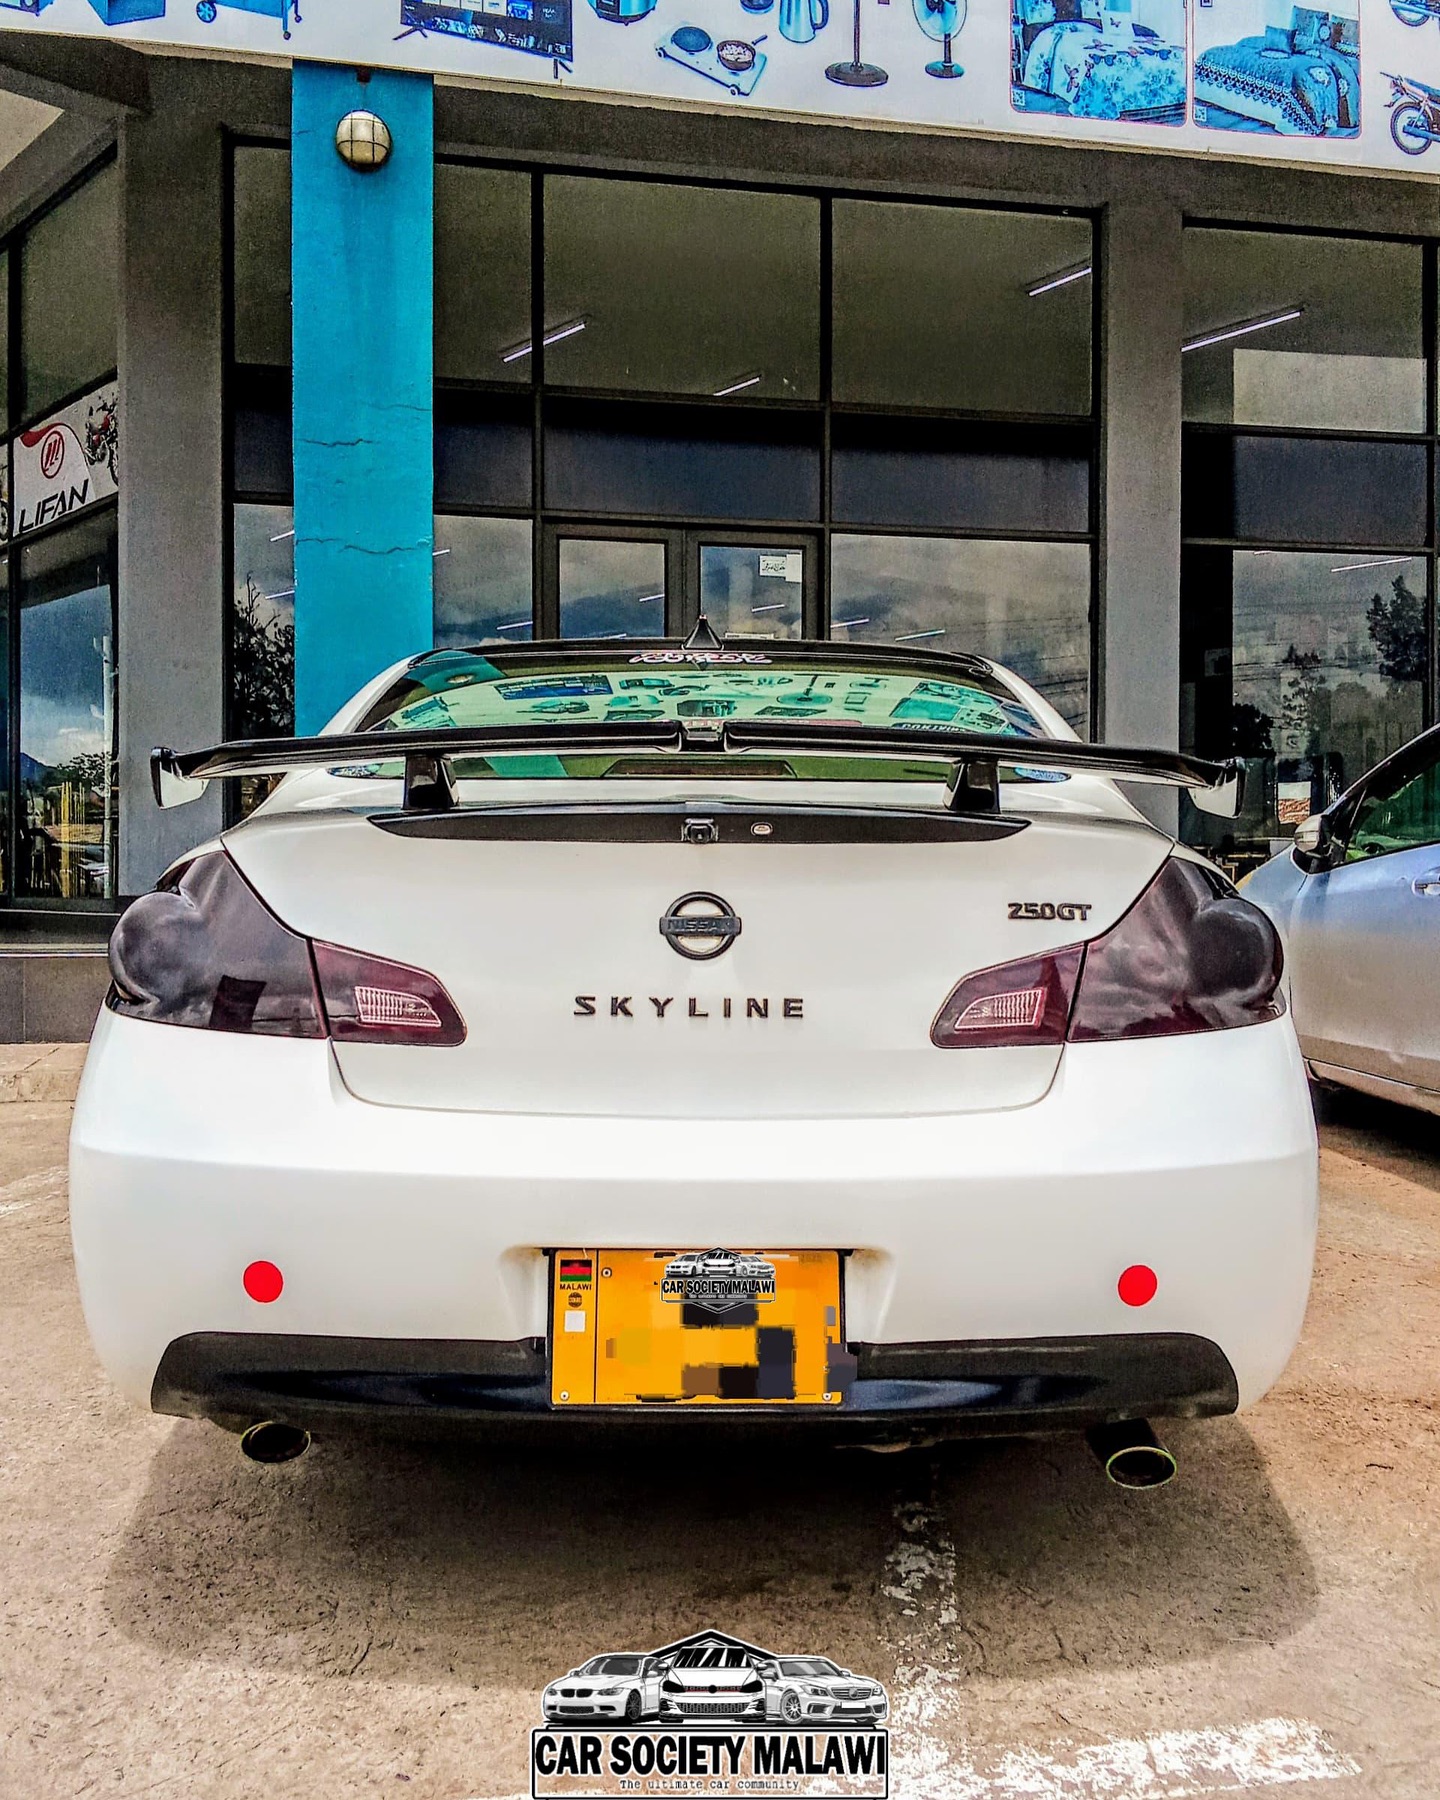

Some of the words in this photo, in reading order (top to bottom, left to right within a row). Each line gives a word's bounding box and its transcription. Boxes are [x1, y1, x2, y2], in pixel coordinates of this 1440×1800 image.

[18, 479, 89, 533] LIFAN
[1007, 902, 1093, 921] 250GT
[573, 995, 804, 1018] SKYLINE
[559, 1283, 592, 1291] MALAWI
